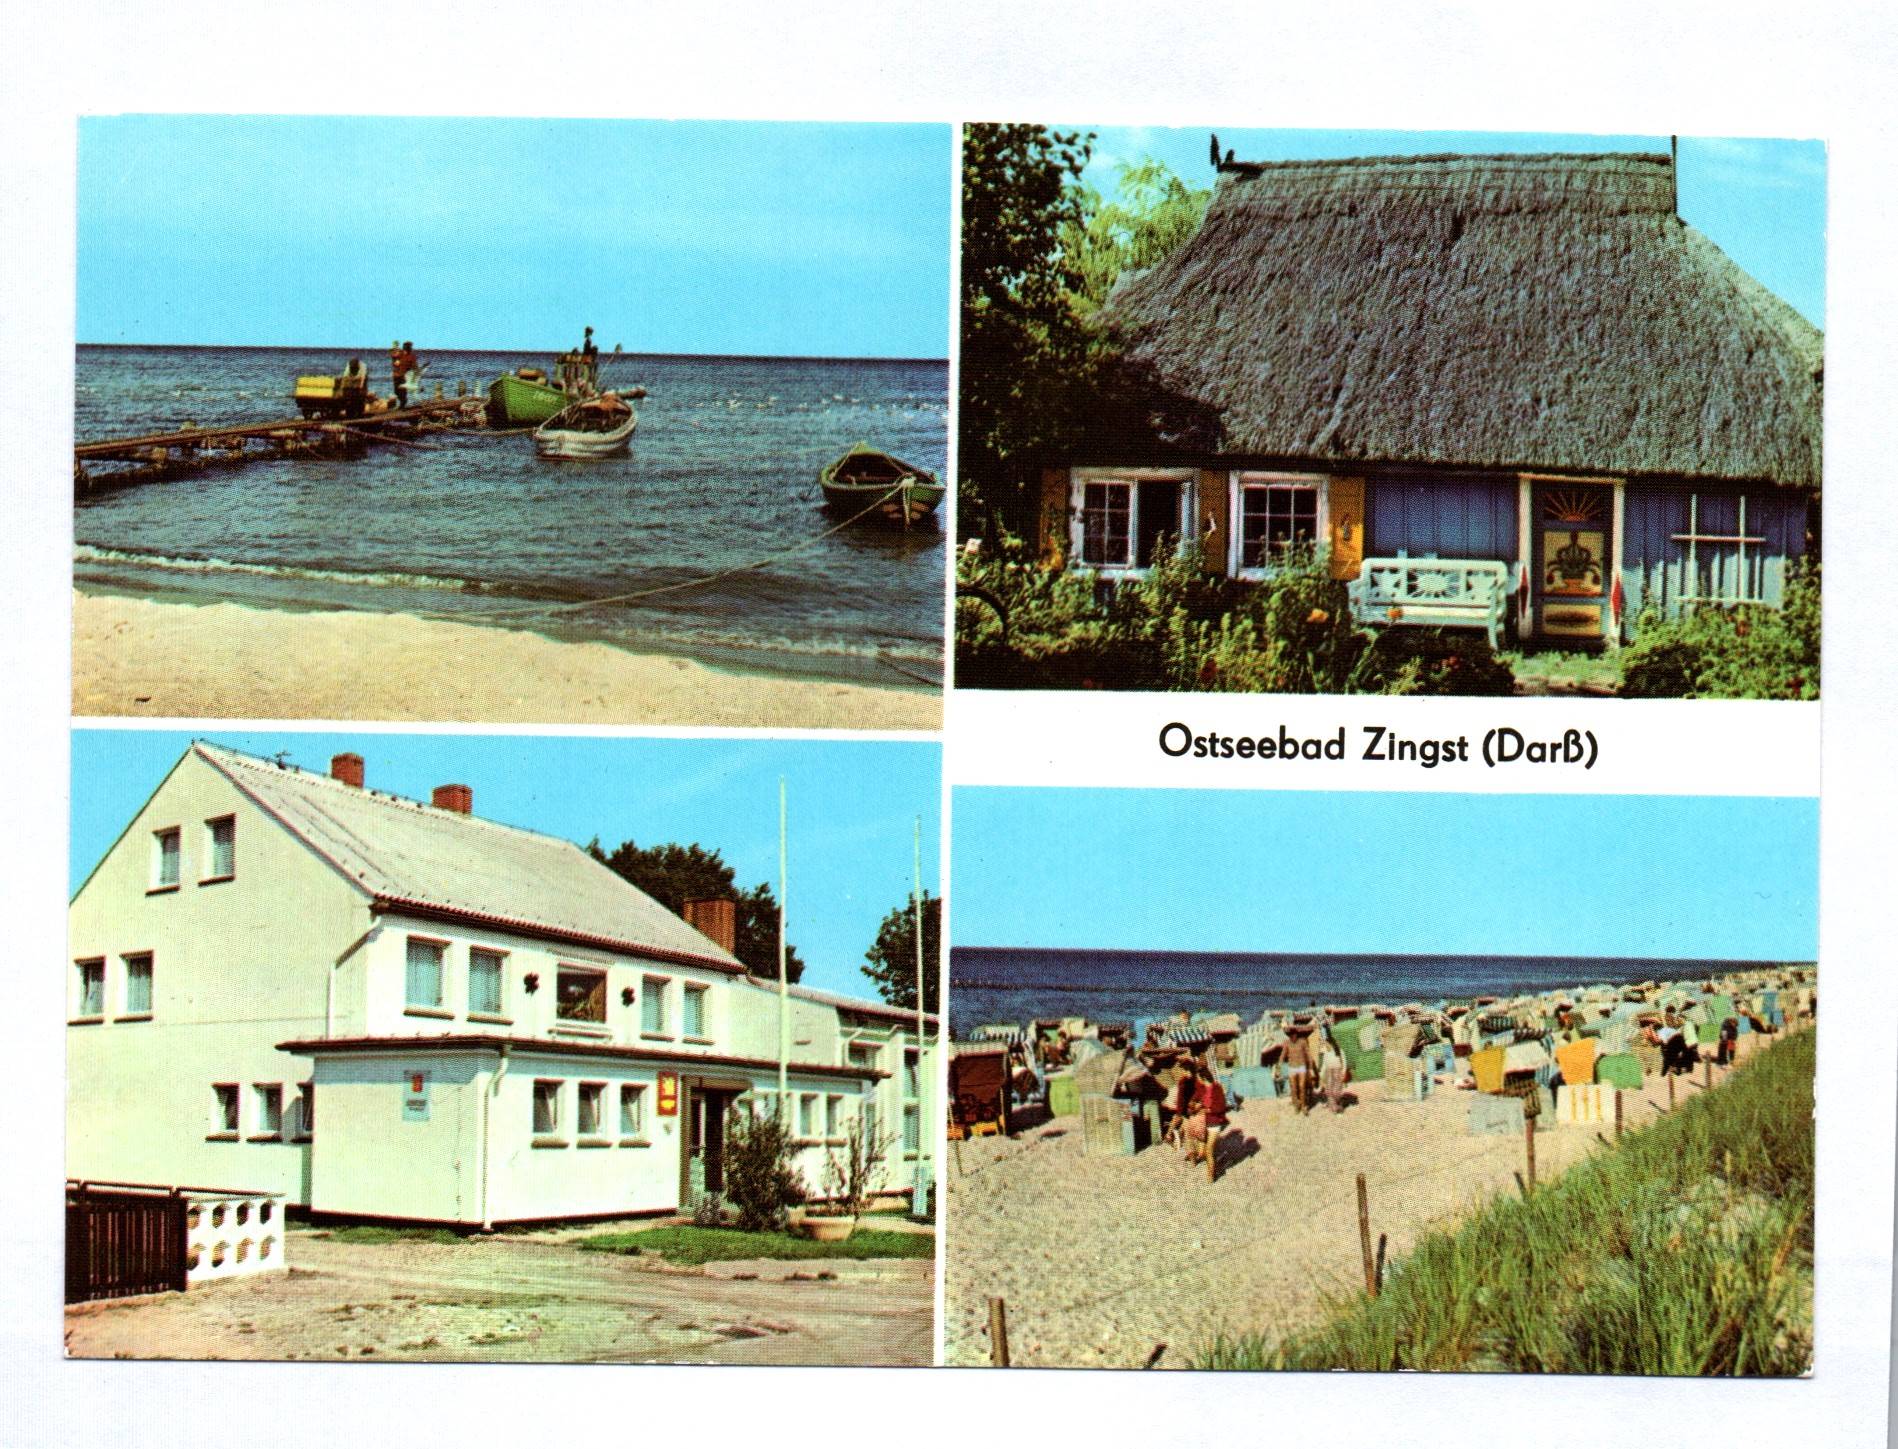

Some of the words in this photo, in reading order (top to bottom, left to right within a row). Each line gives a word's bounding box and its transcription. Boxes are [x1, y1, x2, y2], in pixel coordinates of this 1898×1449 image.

[1159, 722, 1345, 761] Ostseebad
[1362, 726, 1469, 769] Zingst
[1483, 728, 1598, 770] (Darß)
